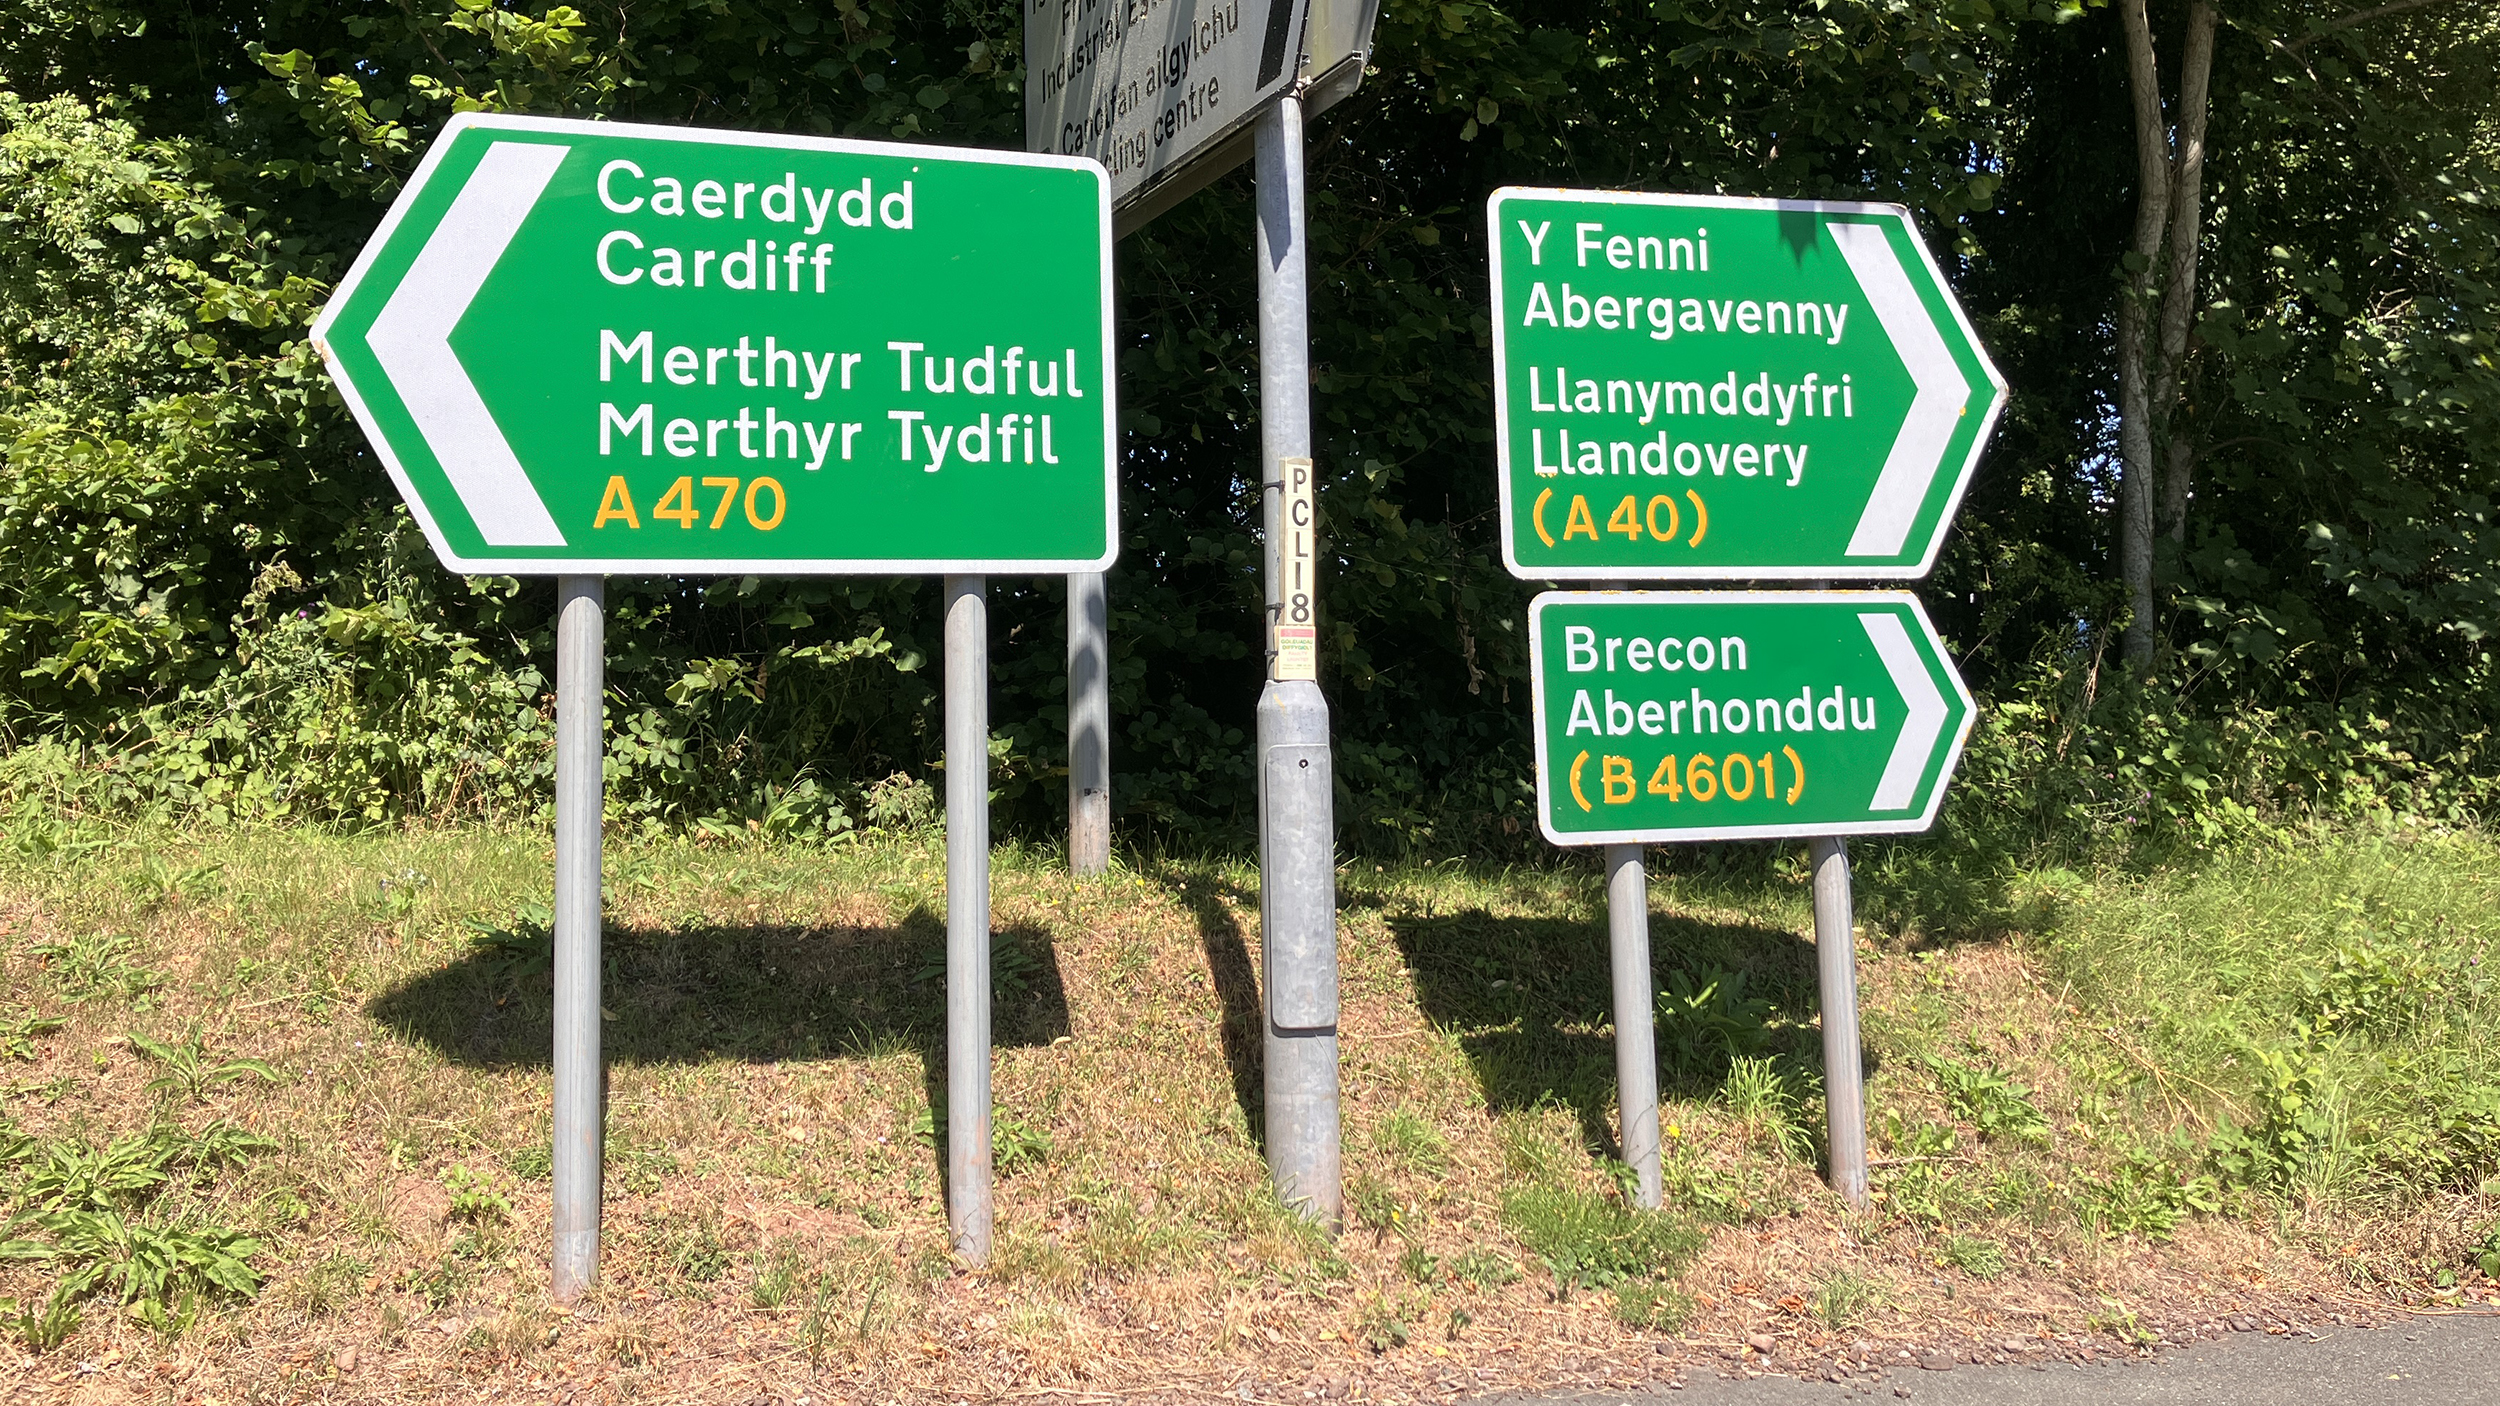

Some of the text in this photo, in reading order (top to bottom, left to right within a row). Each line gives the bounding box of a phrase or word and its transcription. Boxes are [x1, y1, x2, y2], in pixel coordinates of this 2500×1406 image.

[1042, 2, 1121, 104] Industrial
[1145, 0, 1240, 97] ailgylchu
[1153, 75, 1221, 148] centre
[596, 159, 914, 236] Caerdydd
[596, 229, 834, 294] Cardiff
[1517, 219, 1709, 272] Y Fenni
[1522, 281, 1849, 346] Abergavenny
[599, 329, 1084, 401] Merthyr Tudful
[1529, 366, 1853, 427] Llanymddyfri
[599, 402, 1059, 473] Merthyr Tydfil
[1532, 428, 1809, 487] Llandovery
[1564, 625, 1747, 673] Brecon
[1565, 685, 1876, 737] Aberhonddu
